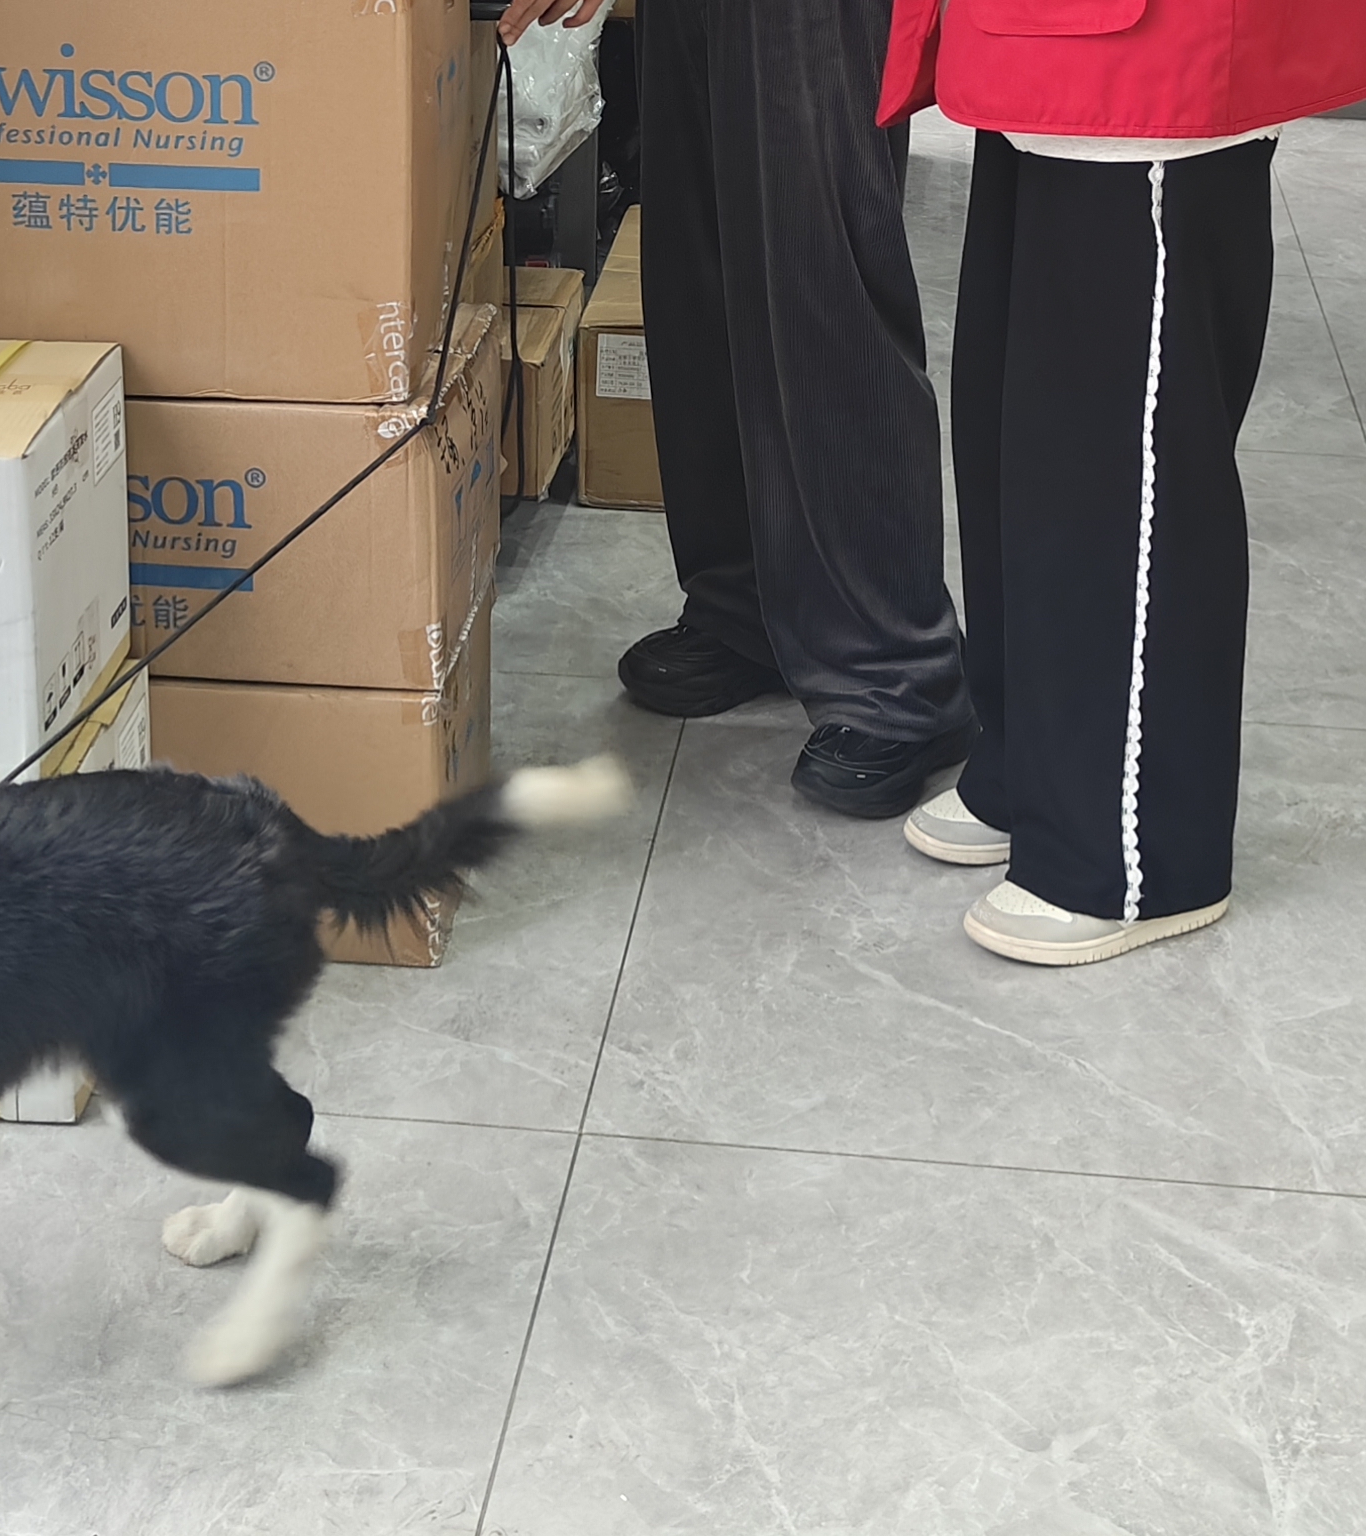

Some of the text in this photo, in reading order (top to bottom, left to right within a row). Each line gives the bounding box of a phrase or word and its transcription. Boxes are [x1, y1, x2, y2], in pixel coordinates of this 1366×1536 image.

[132, 128, 245, 156] Nursing
[11, 191, 195, 236] 蕴特优能
[131, 529, 238, 560] Nursing
